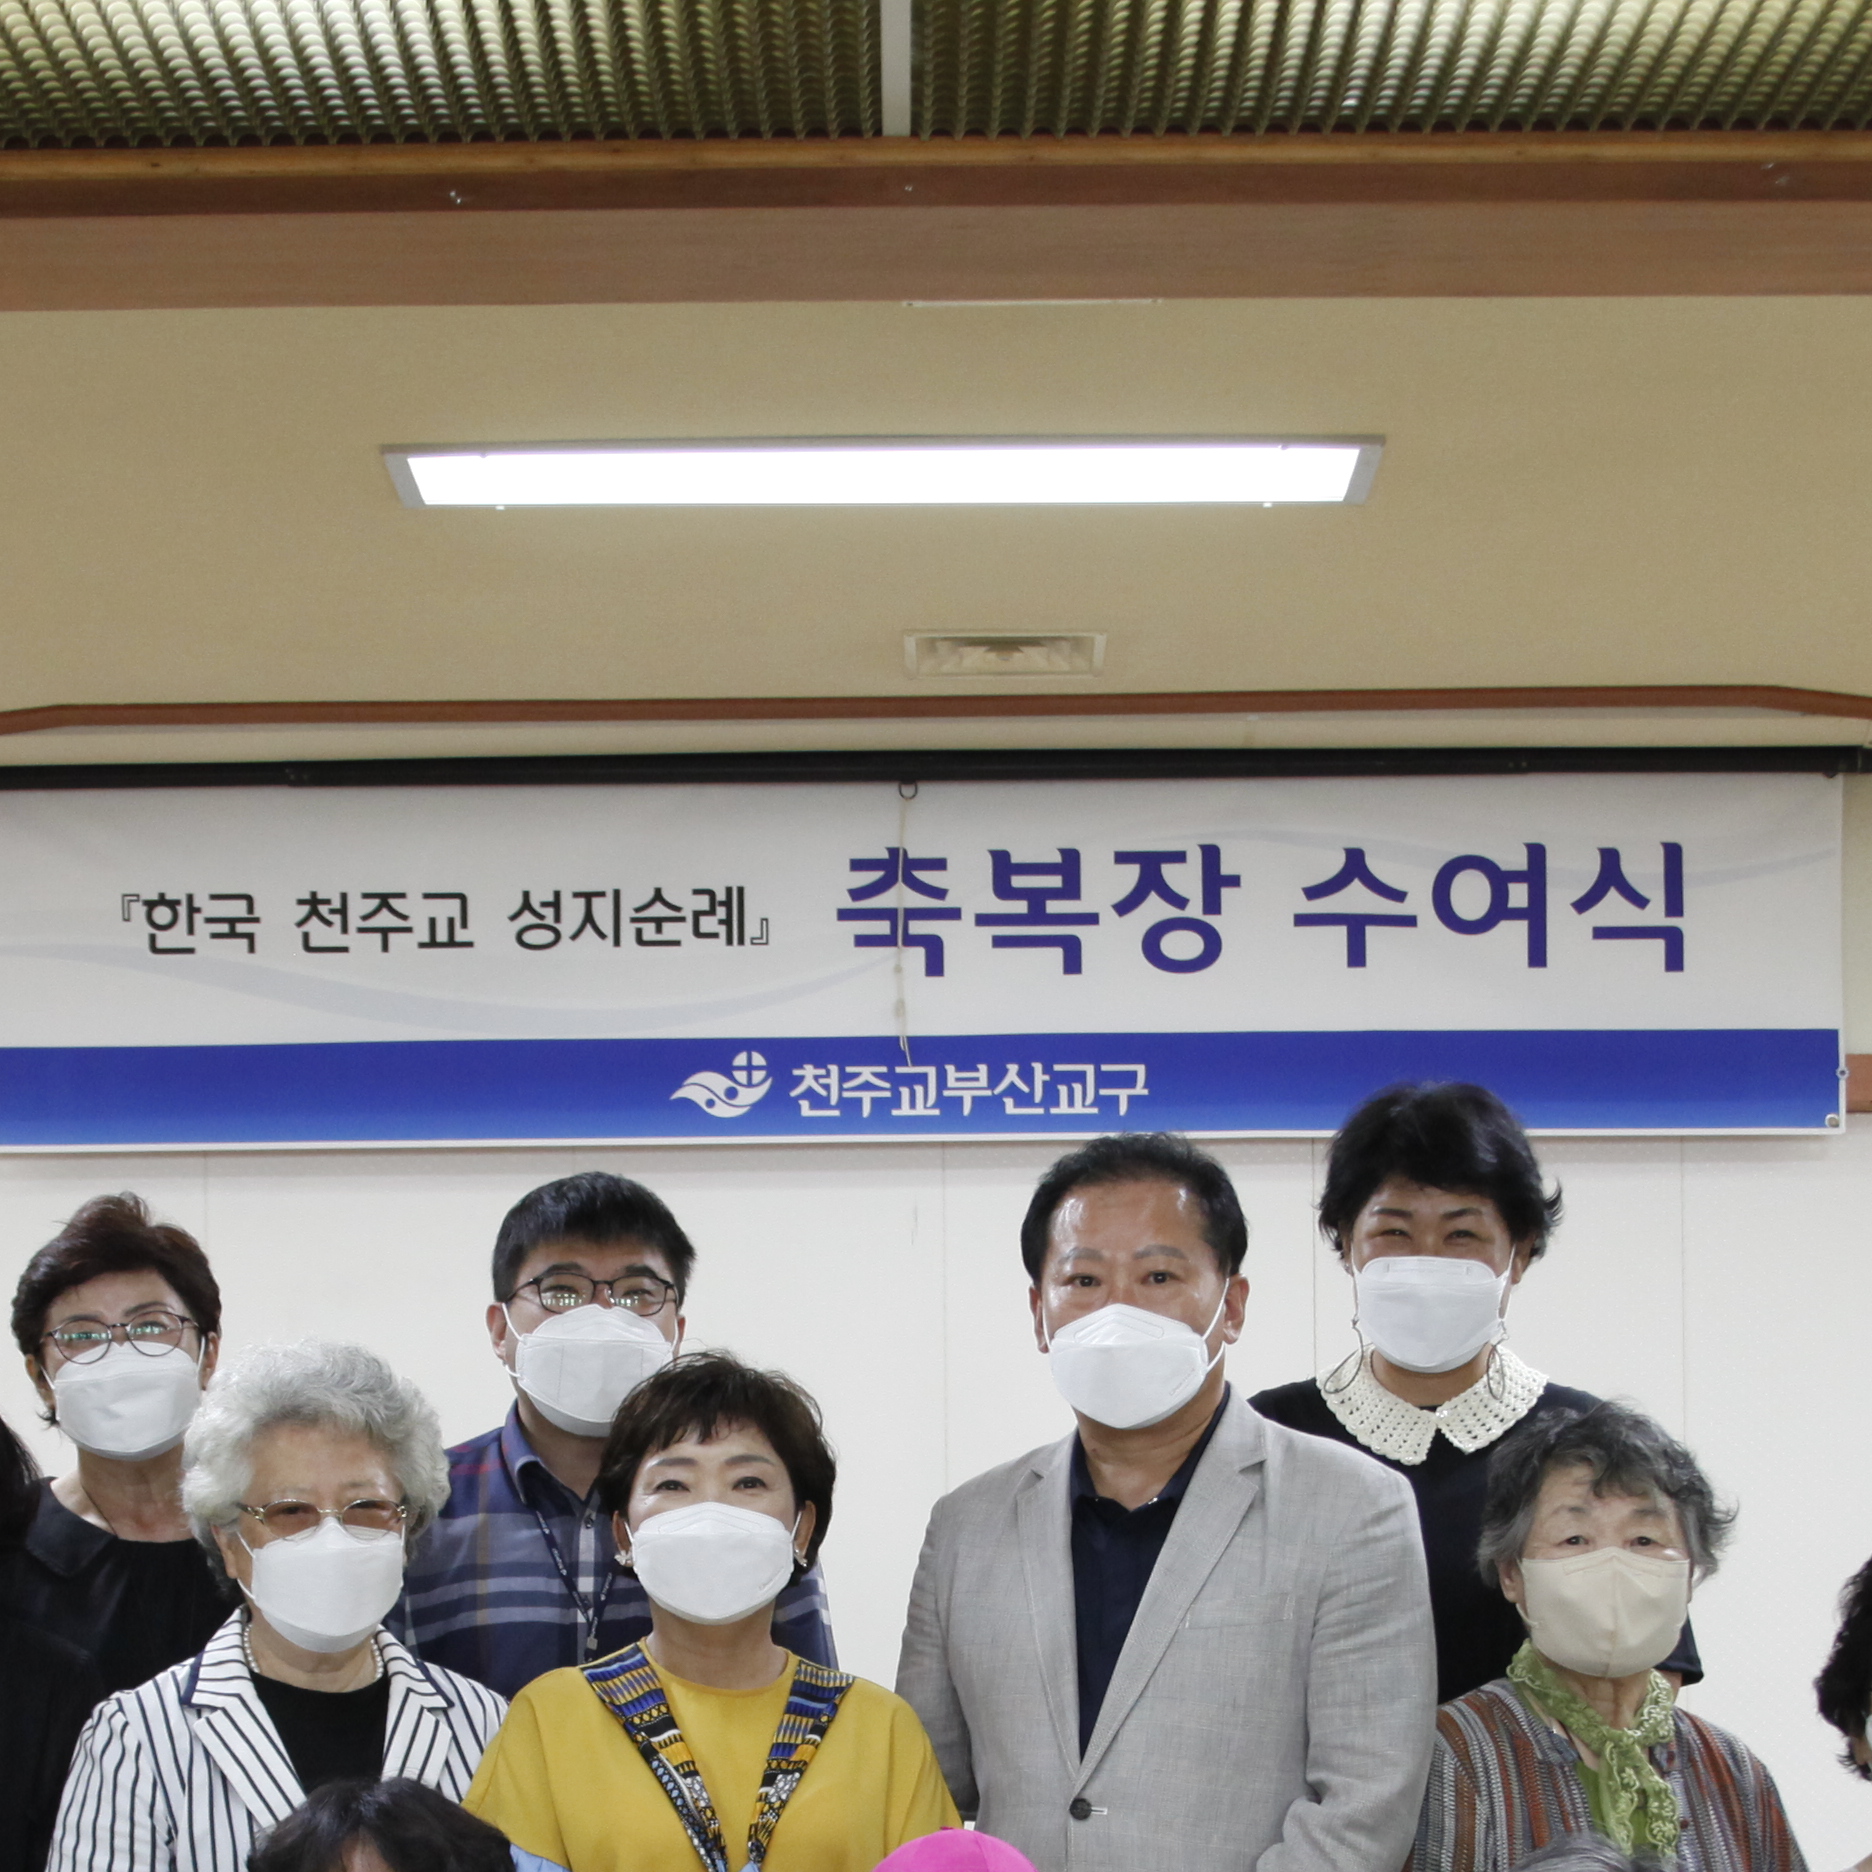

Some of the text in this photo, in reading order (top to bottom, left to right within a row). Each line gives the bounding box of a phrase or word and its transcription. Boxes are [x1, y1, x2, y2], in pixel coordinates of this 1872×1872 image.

[294, 890, 475, 955] 천주교
[835, 844, 1243, 977] 축복장
[1292, 841, 1685, 972] 수여식
[788, 1062, 1150, 1118] 천주교부산교구
